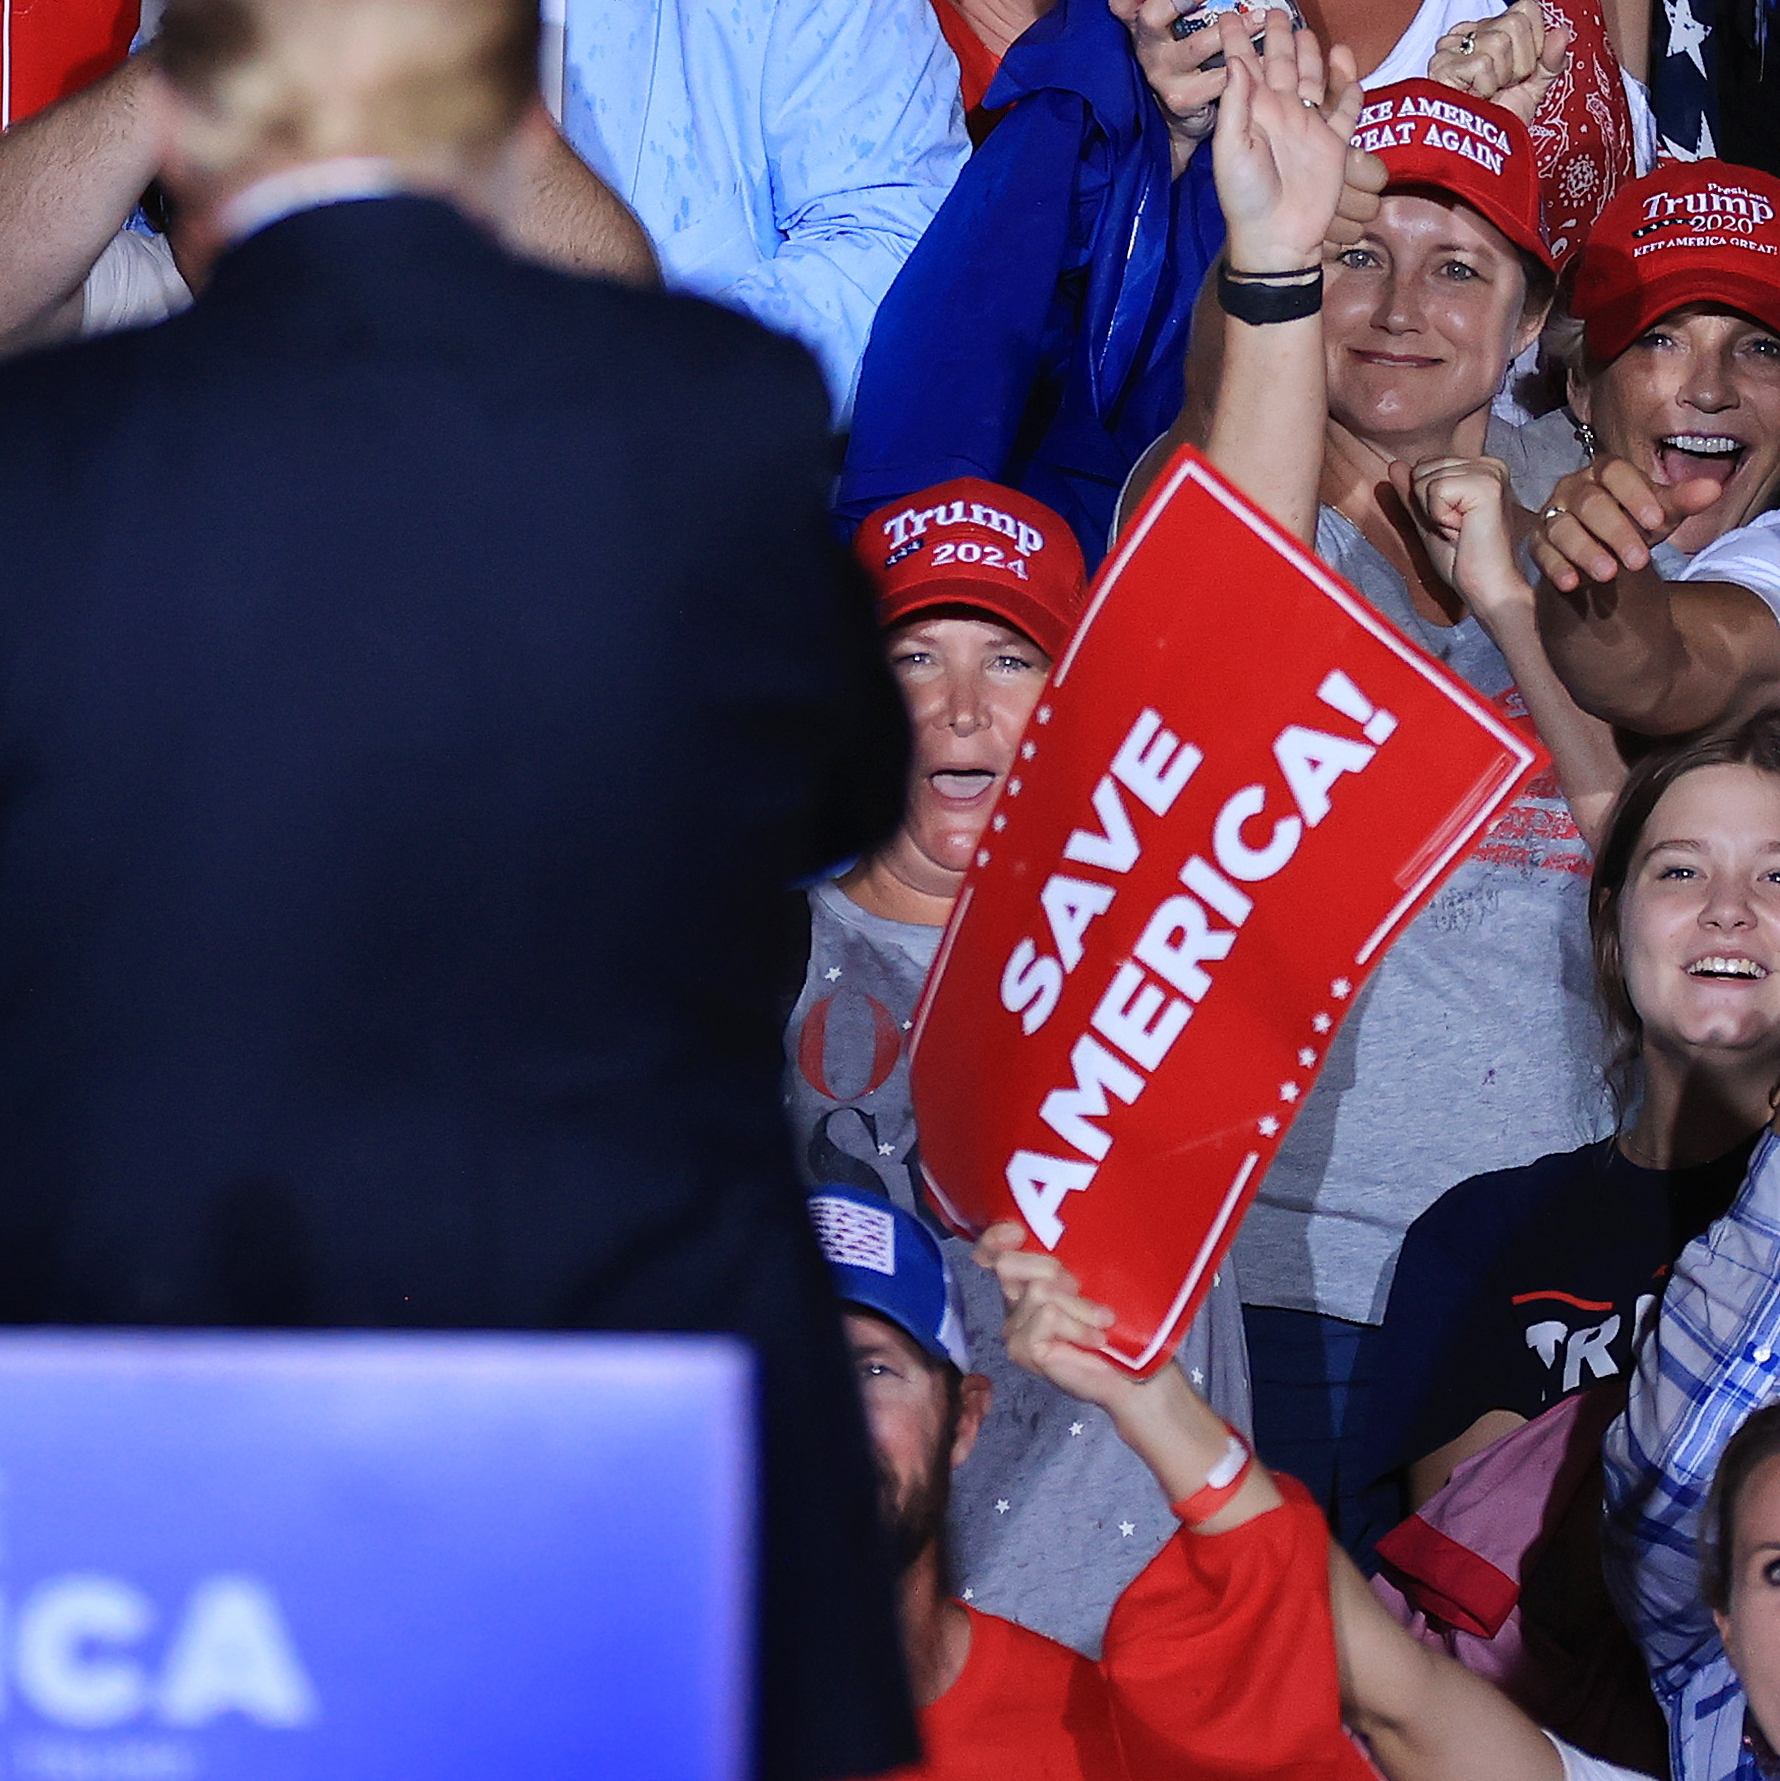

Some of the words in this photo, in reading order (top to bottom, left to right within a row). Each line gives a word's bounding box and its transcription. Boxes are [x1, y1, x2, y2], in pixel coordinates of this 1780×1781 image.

[1396, 96, 1513, 157] AMERICA
[1422, 122, 1505, 176] AGAIN
[1642, 191, 1776, 225] Trump
[1707, 182, 1771, 204] President
[1634, 240, 1666, 258] KEEP
[1666, 235, 1728, 248] AMERICA
[1729, 236, 1779, 256] GREAT!
[1690, 213, 1755, 236] 2020
[884, 499, 1045, 558] Trump
[931, 542, 1029, 581] 2024
[1001, 707, 1204, 1035] SAVE
[1005, 668, 1399, 1251] AMERICA!
